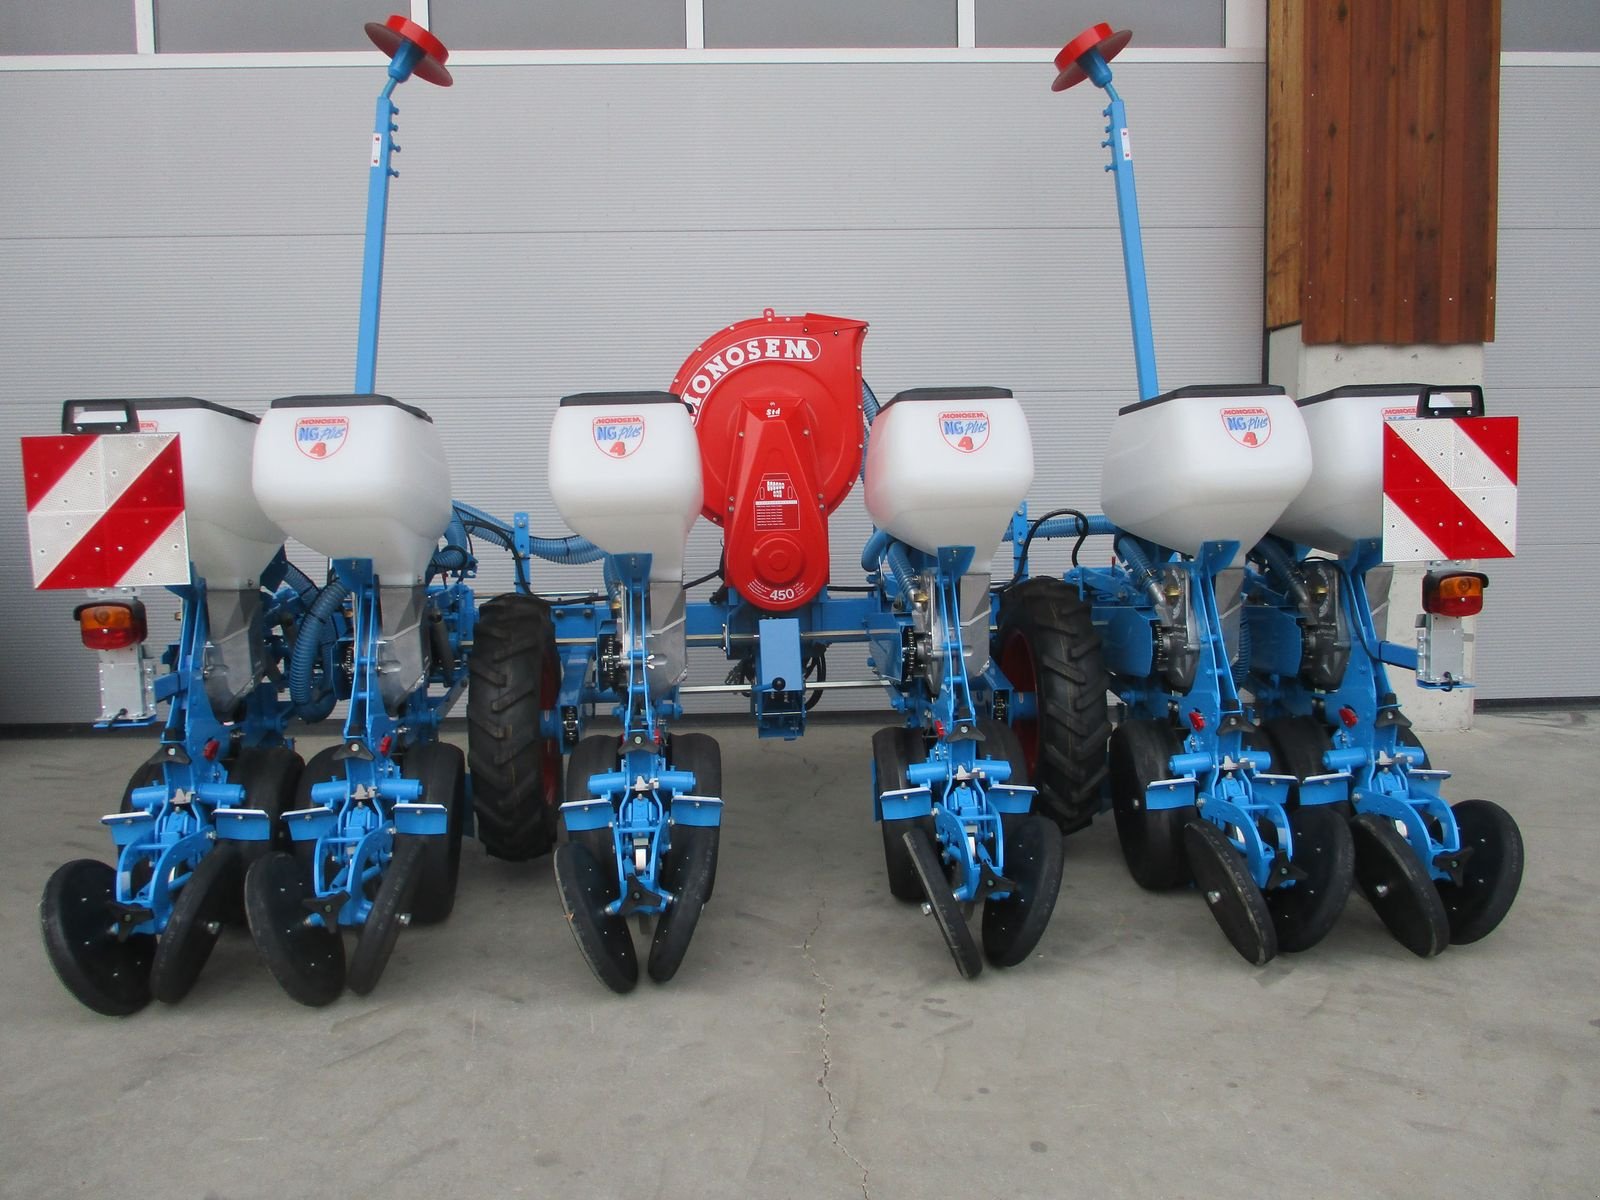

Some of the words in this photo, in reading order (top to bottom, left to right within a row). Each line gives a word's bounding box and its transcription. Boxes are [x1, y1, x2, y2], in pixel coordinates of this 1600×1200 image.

[595, 416, 641, 424] MONOSEM
[943, 420, 964, 435] NG
[1226, 416, 1247, 431] NG
[297, 427, 319, 441] NG
[596, 426, 617, 441] NG
[1242, 431, 1258, 446] 4
[309, 442, 327, 457] 4
[609, 441, 626, 456] 4
[957, 436, 974, 451] 4
[769, 588, 795, 601] 450
